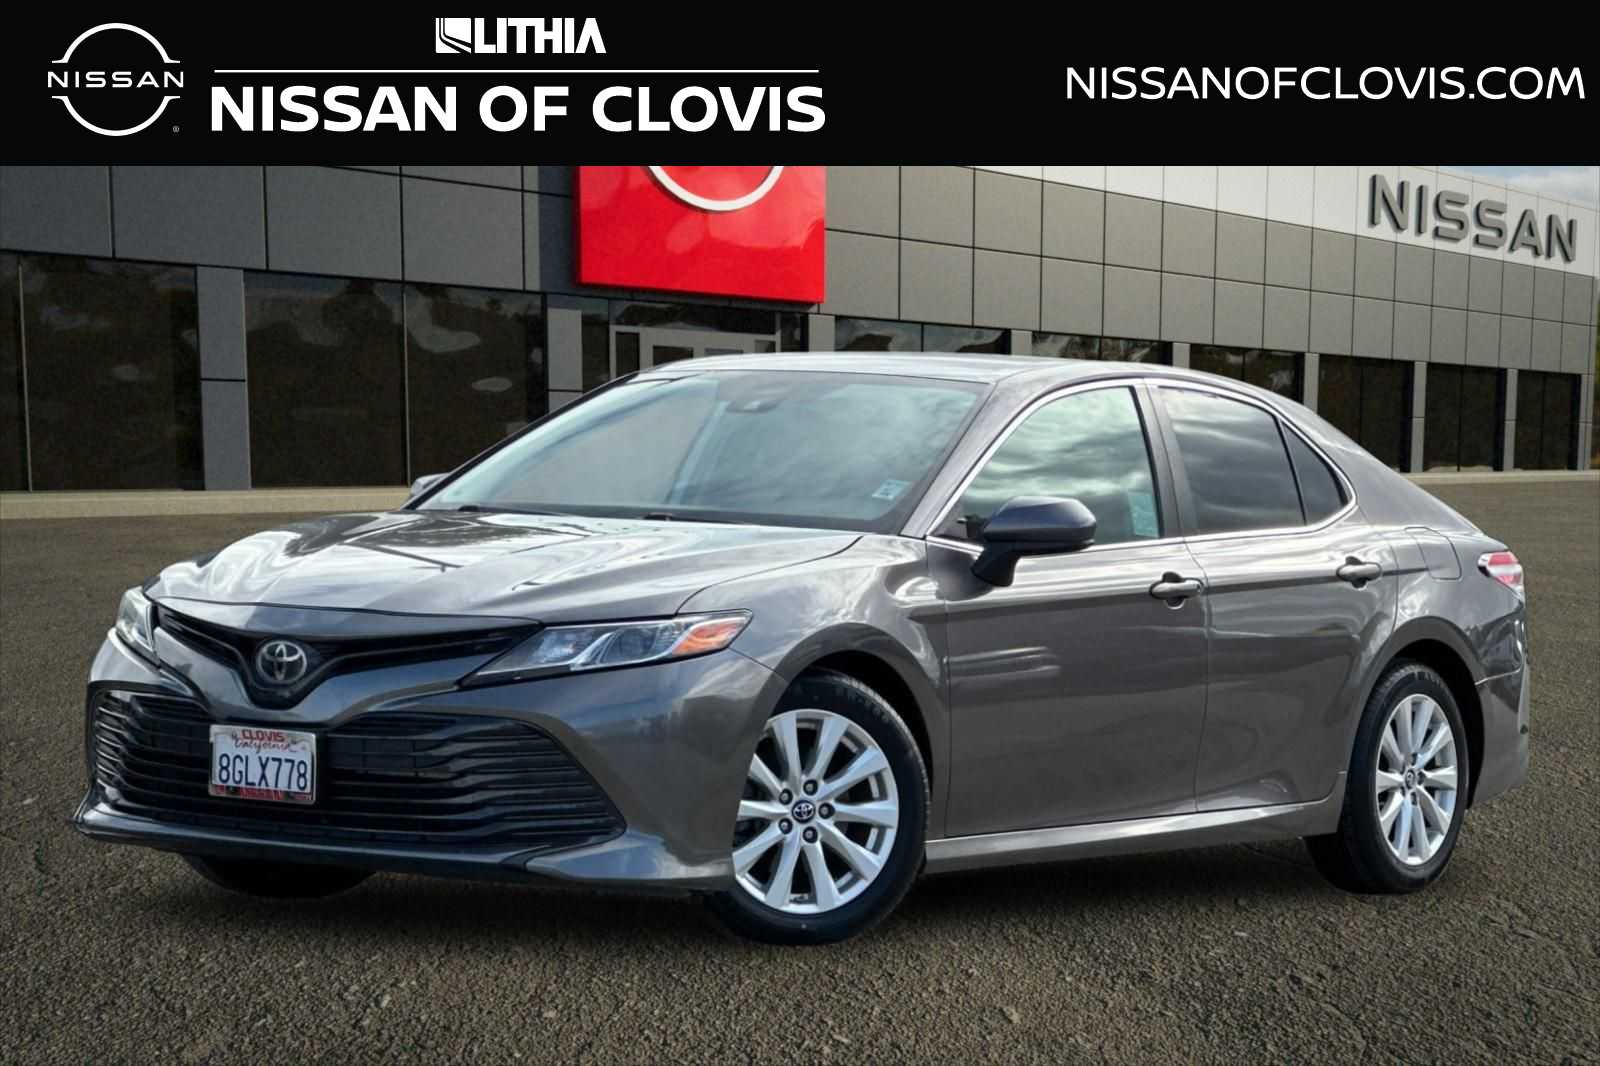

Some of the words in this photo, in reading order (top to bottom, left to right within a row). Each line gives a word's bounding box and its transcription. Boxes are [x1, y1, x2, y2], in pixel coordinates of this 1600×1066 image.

[1368, 173, 1578, 263] NISSAN
[241, 729, 286, 743] CLOVIS
[218, 753, 308, 791] 8GLX778
